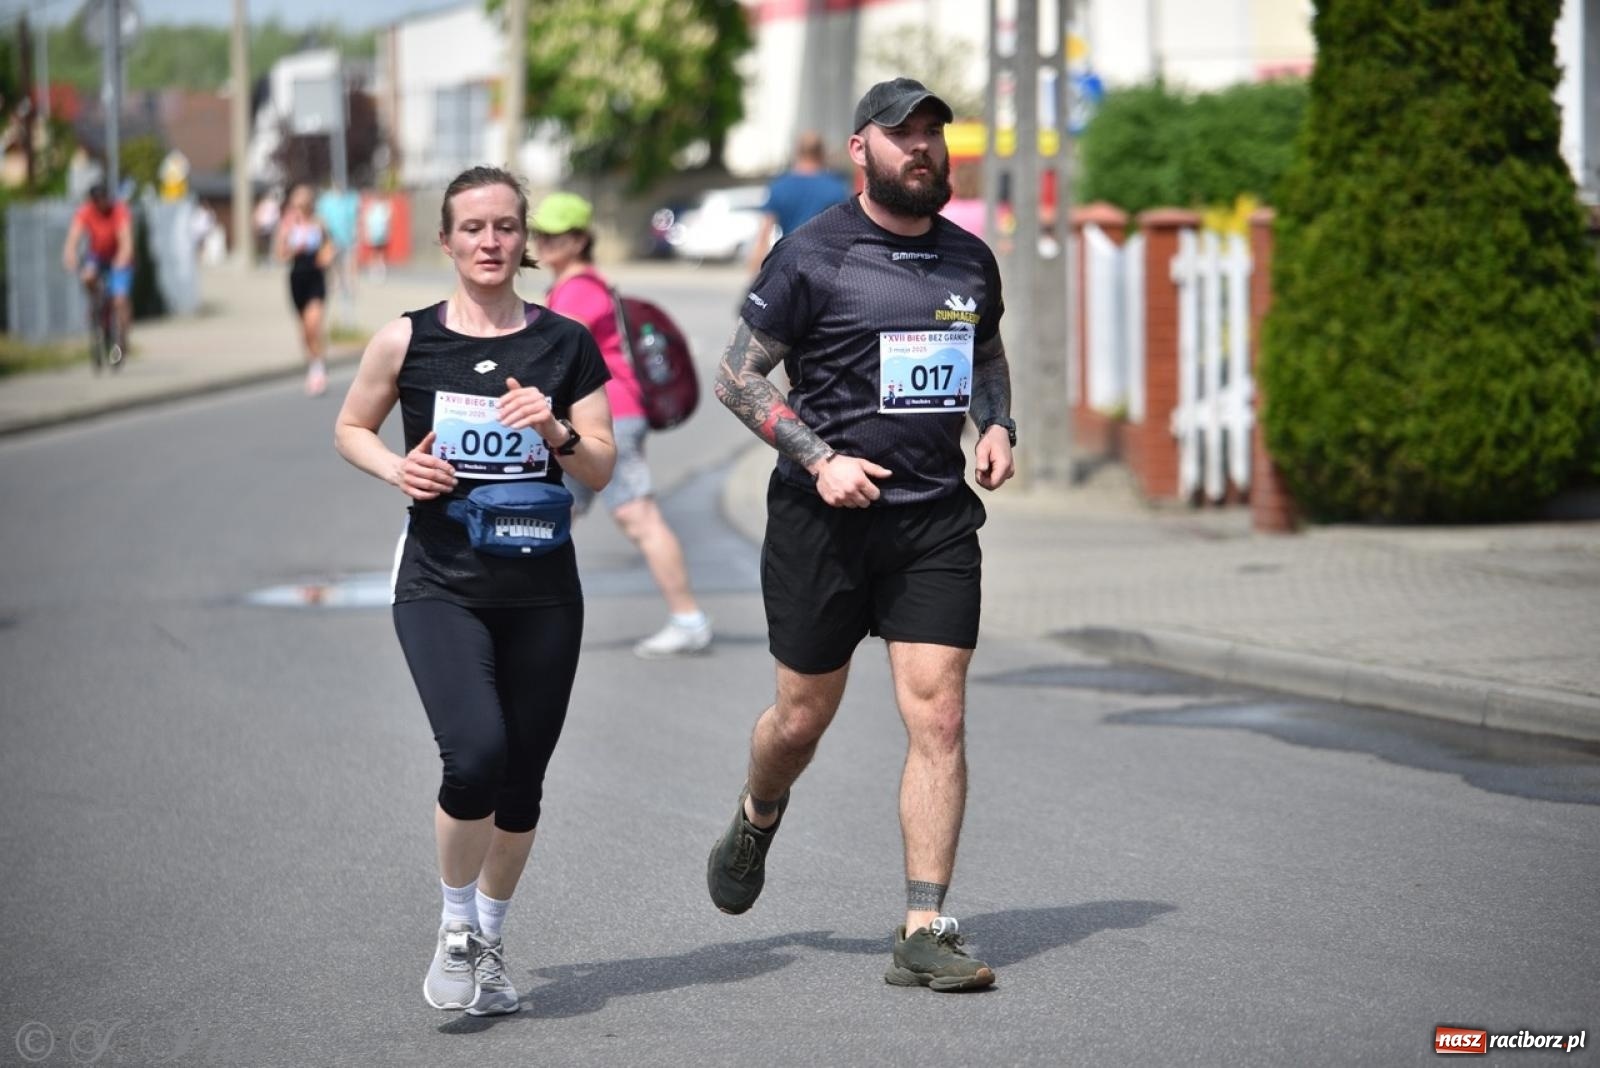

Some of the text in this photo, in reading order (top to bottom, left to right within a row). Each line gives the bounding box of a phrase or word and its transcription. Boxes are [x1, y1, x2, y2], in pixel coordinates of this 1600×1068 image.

[888, 334, 905, 342] XVII
[907, 334, 927, 342] BIEG
[944, 333, 968, 341] GRANIC
[911, 365, 954, 391] 017
[465, 398, 486, 407] BIEG
[461, 429, 523, 457] 002
